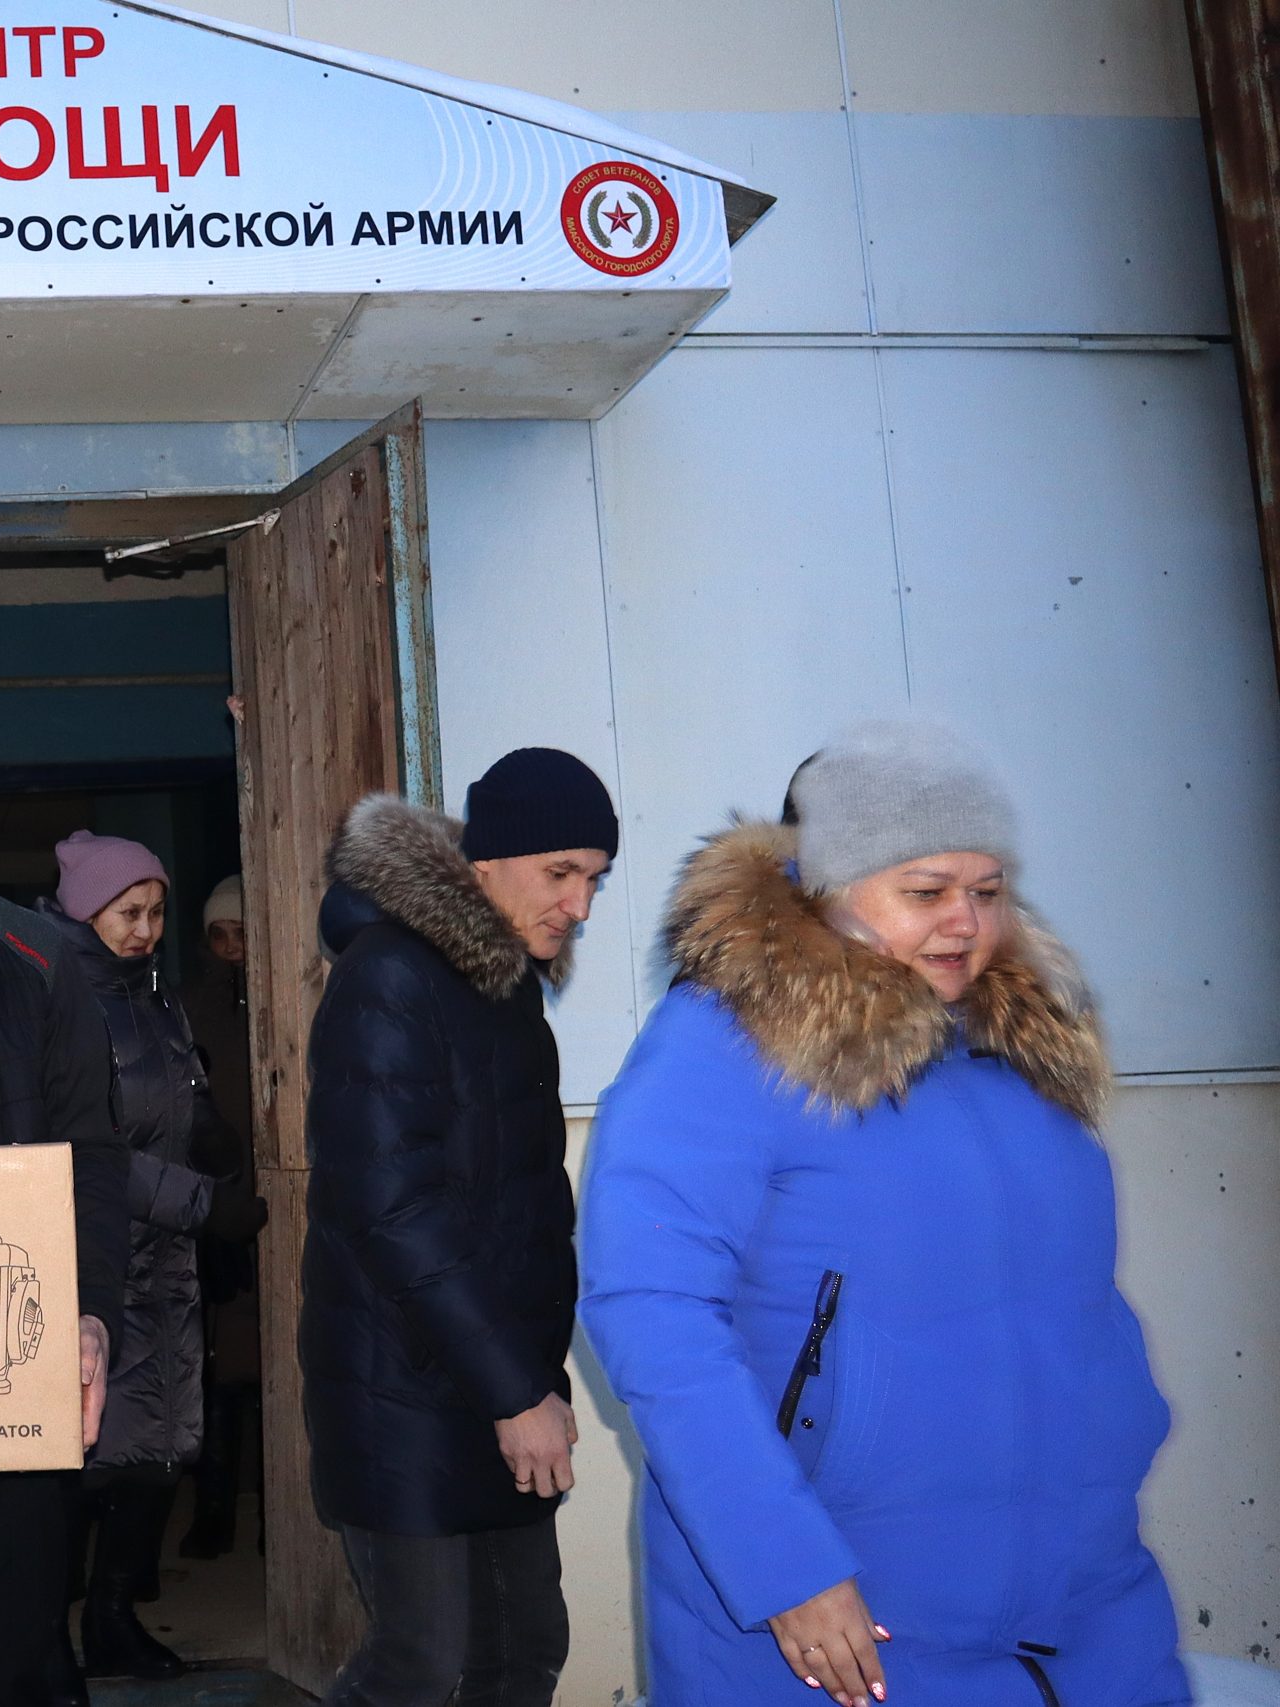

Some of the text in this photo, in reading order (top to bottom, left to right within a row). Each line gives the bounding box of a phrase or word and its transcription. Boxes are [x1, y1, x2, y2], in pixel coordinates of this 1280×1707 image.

[573, 166, 662, 195] СОВЕТ ВЕТЕРАНОВ
[352, 210, 523, 246] АРМИИ
[567, 216, 674, 273] МИАССКОГО ГОРОДСКОГО ОКРУГА
